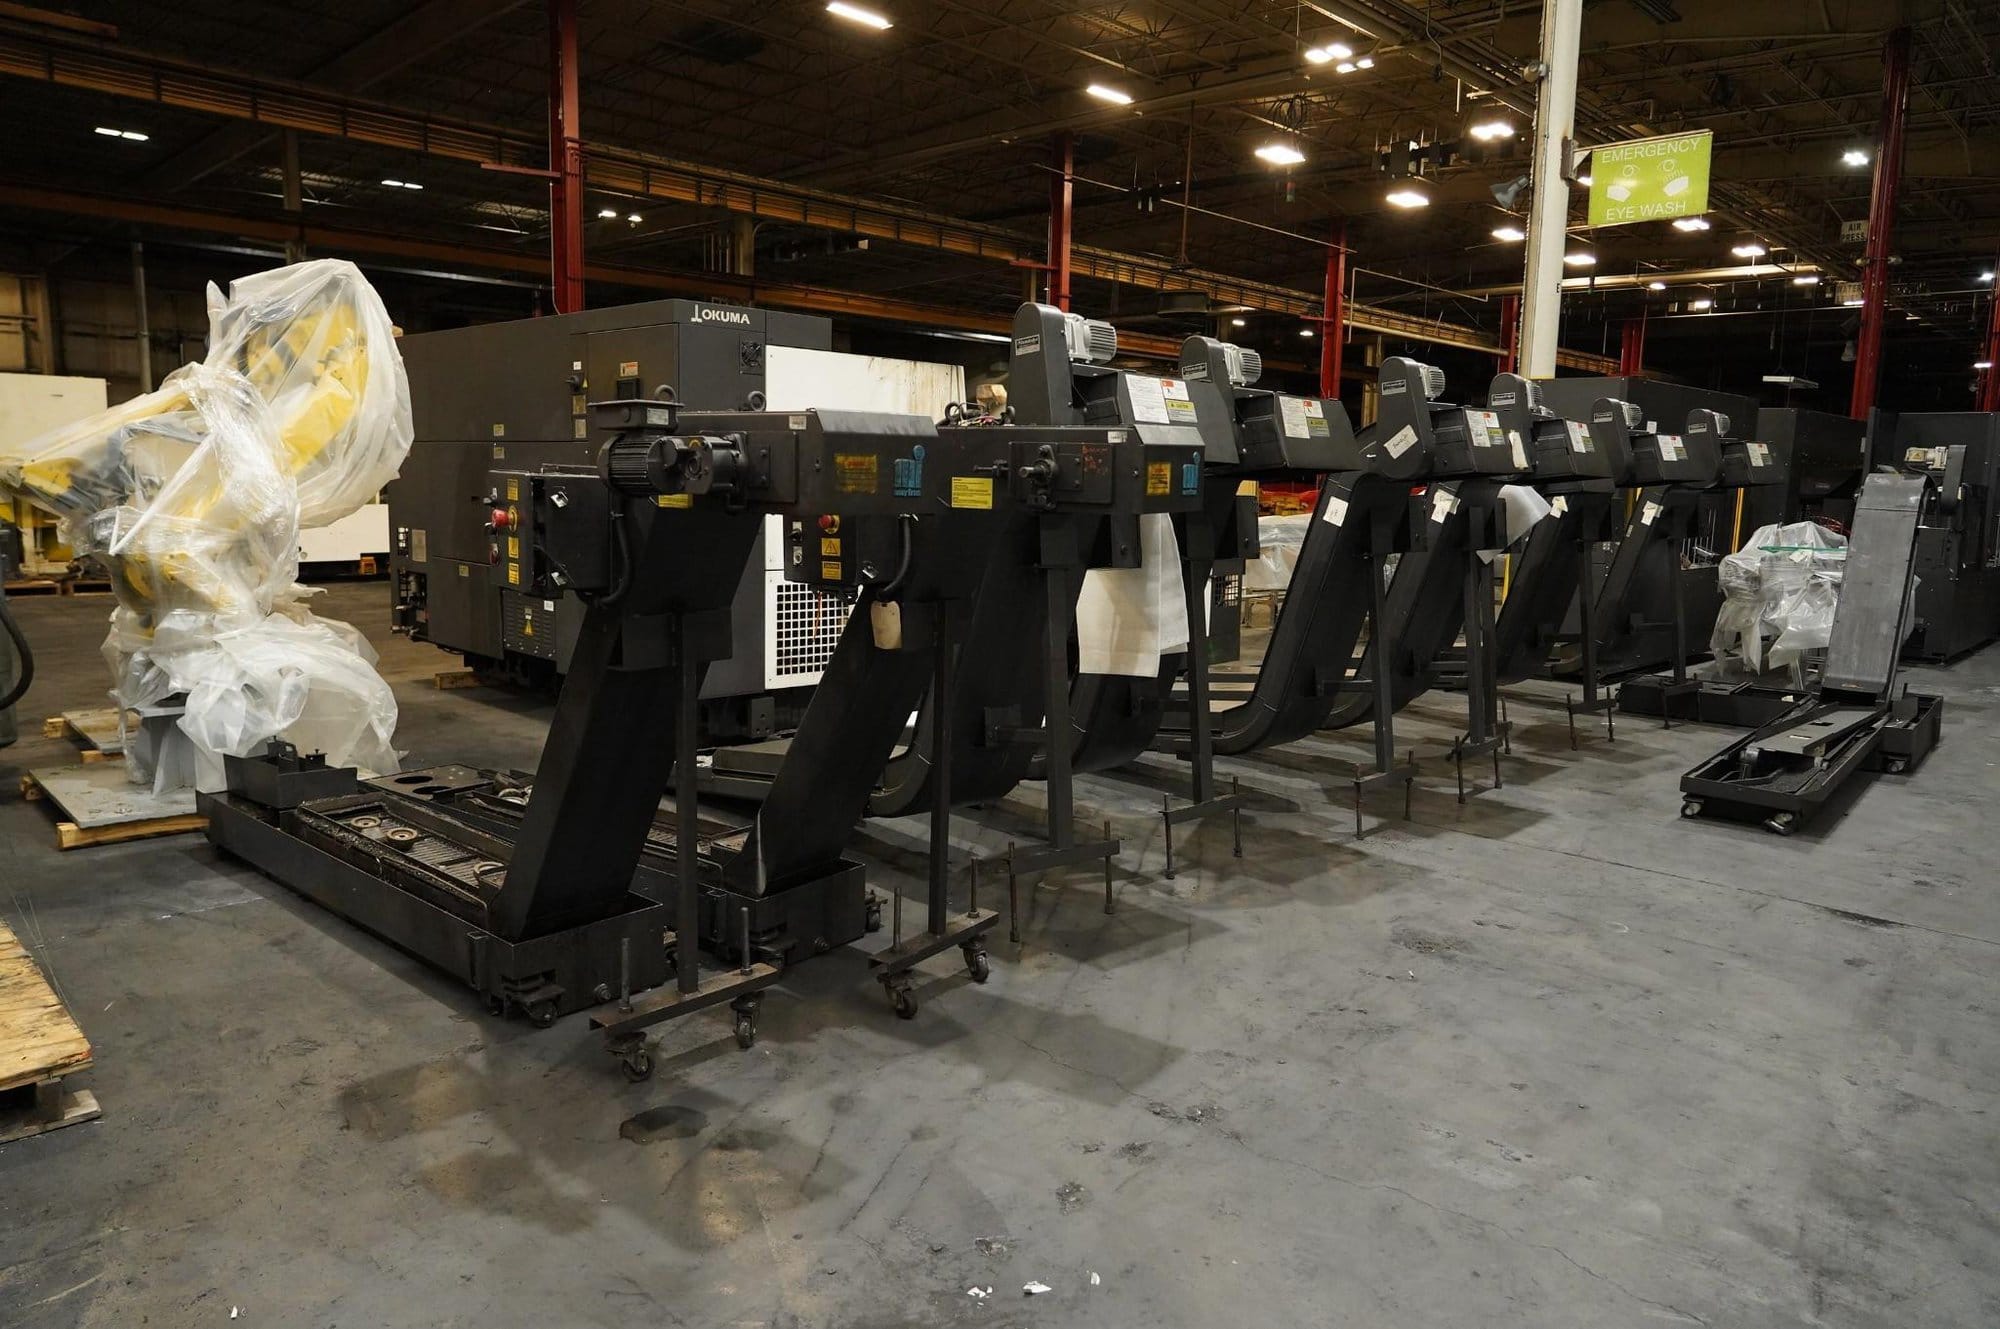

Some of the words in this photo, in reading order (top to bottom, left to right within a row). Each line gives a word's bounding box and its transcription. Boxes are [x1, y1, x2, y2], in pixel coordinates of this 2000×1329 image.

[1602, 138, 1701, 163] EMERGENCY
[1606, 206, 1634, 221] EYE
[1640, 201, 1686, 217] WASH
[1848, 223, 1861, 231] AIR
[701, 309, 751, 324] OKUMA
